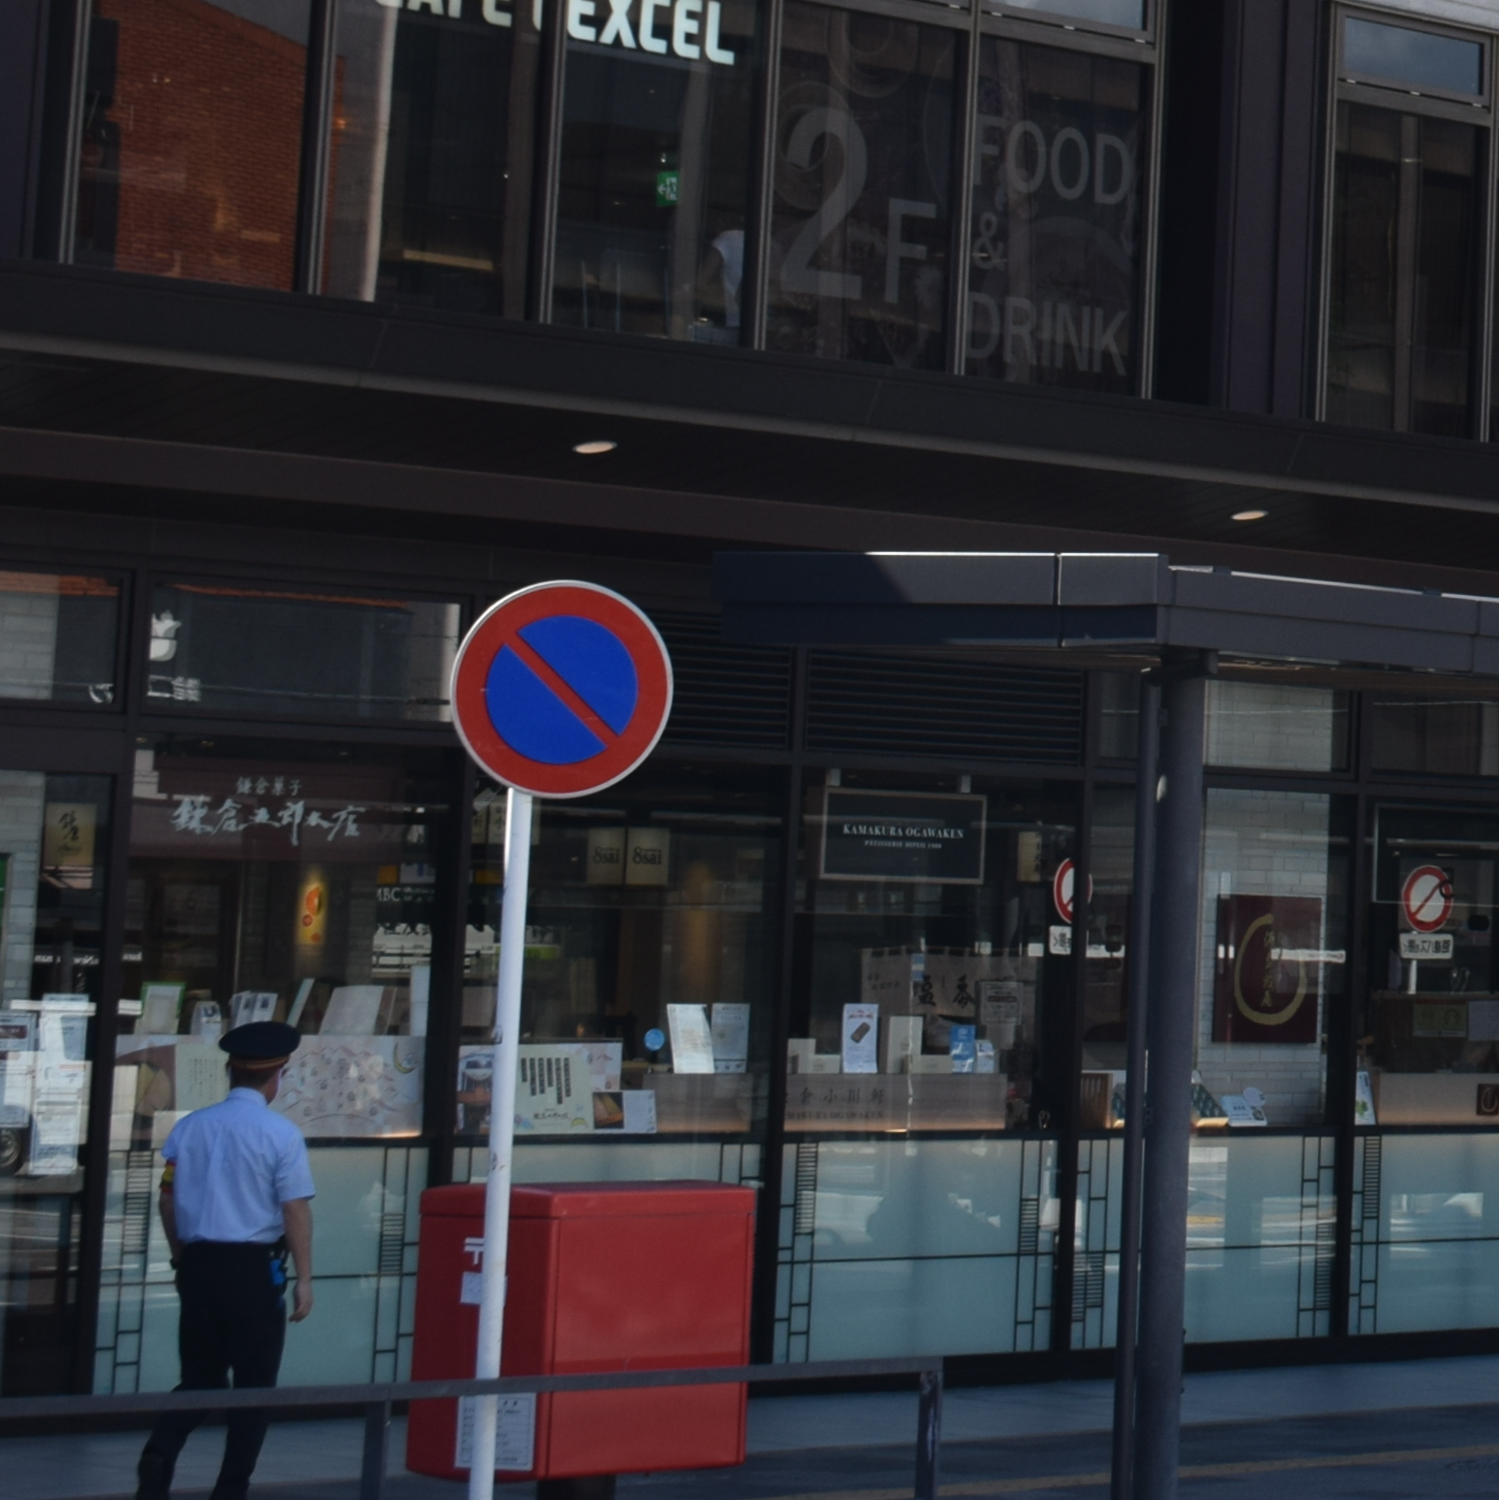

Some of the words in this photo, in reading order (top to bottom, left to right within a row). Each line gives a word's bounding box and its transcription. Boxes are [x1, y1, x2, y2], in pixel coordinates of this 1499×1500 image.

[972, 112, 1131, 206] FOOD
[972, 211, 1006, 272] &
[964, 290, 1128, 377] DRINK
[843, 823, 903, 837] KAMAKURA
[905, 826, 964, 839] OGAWAKEN
[785, 1086, 886, 1105] 倉小川軒
